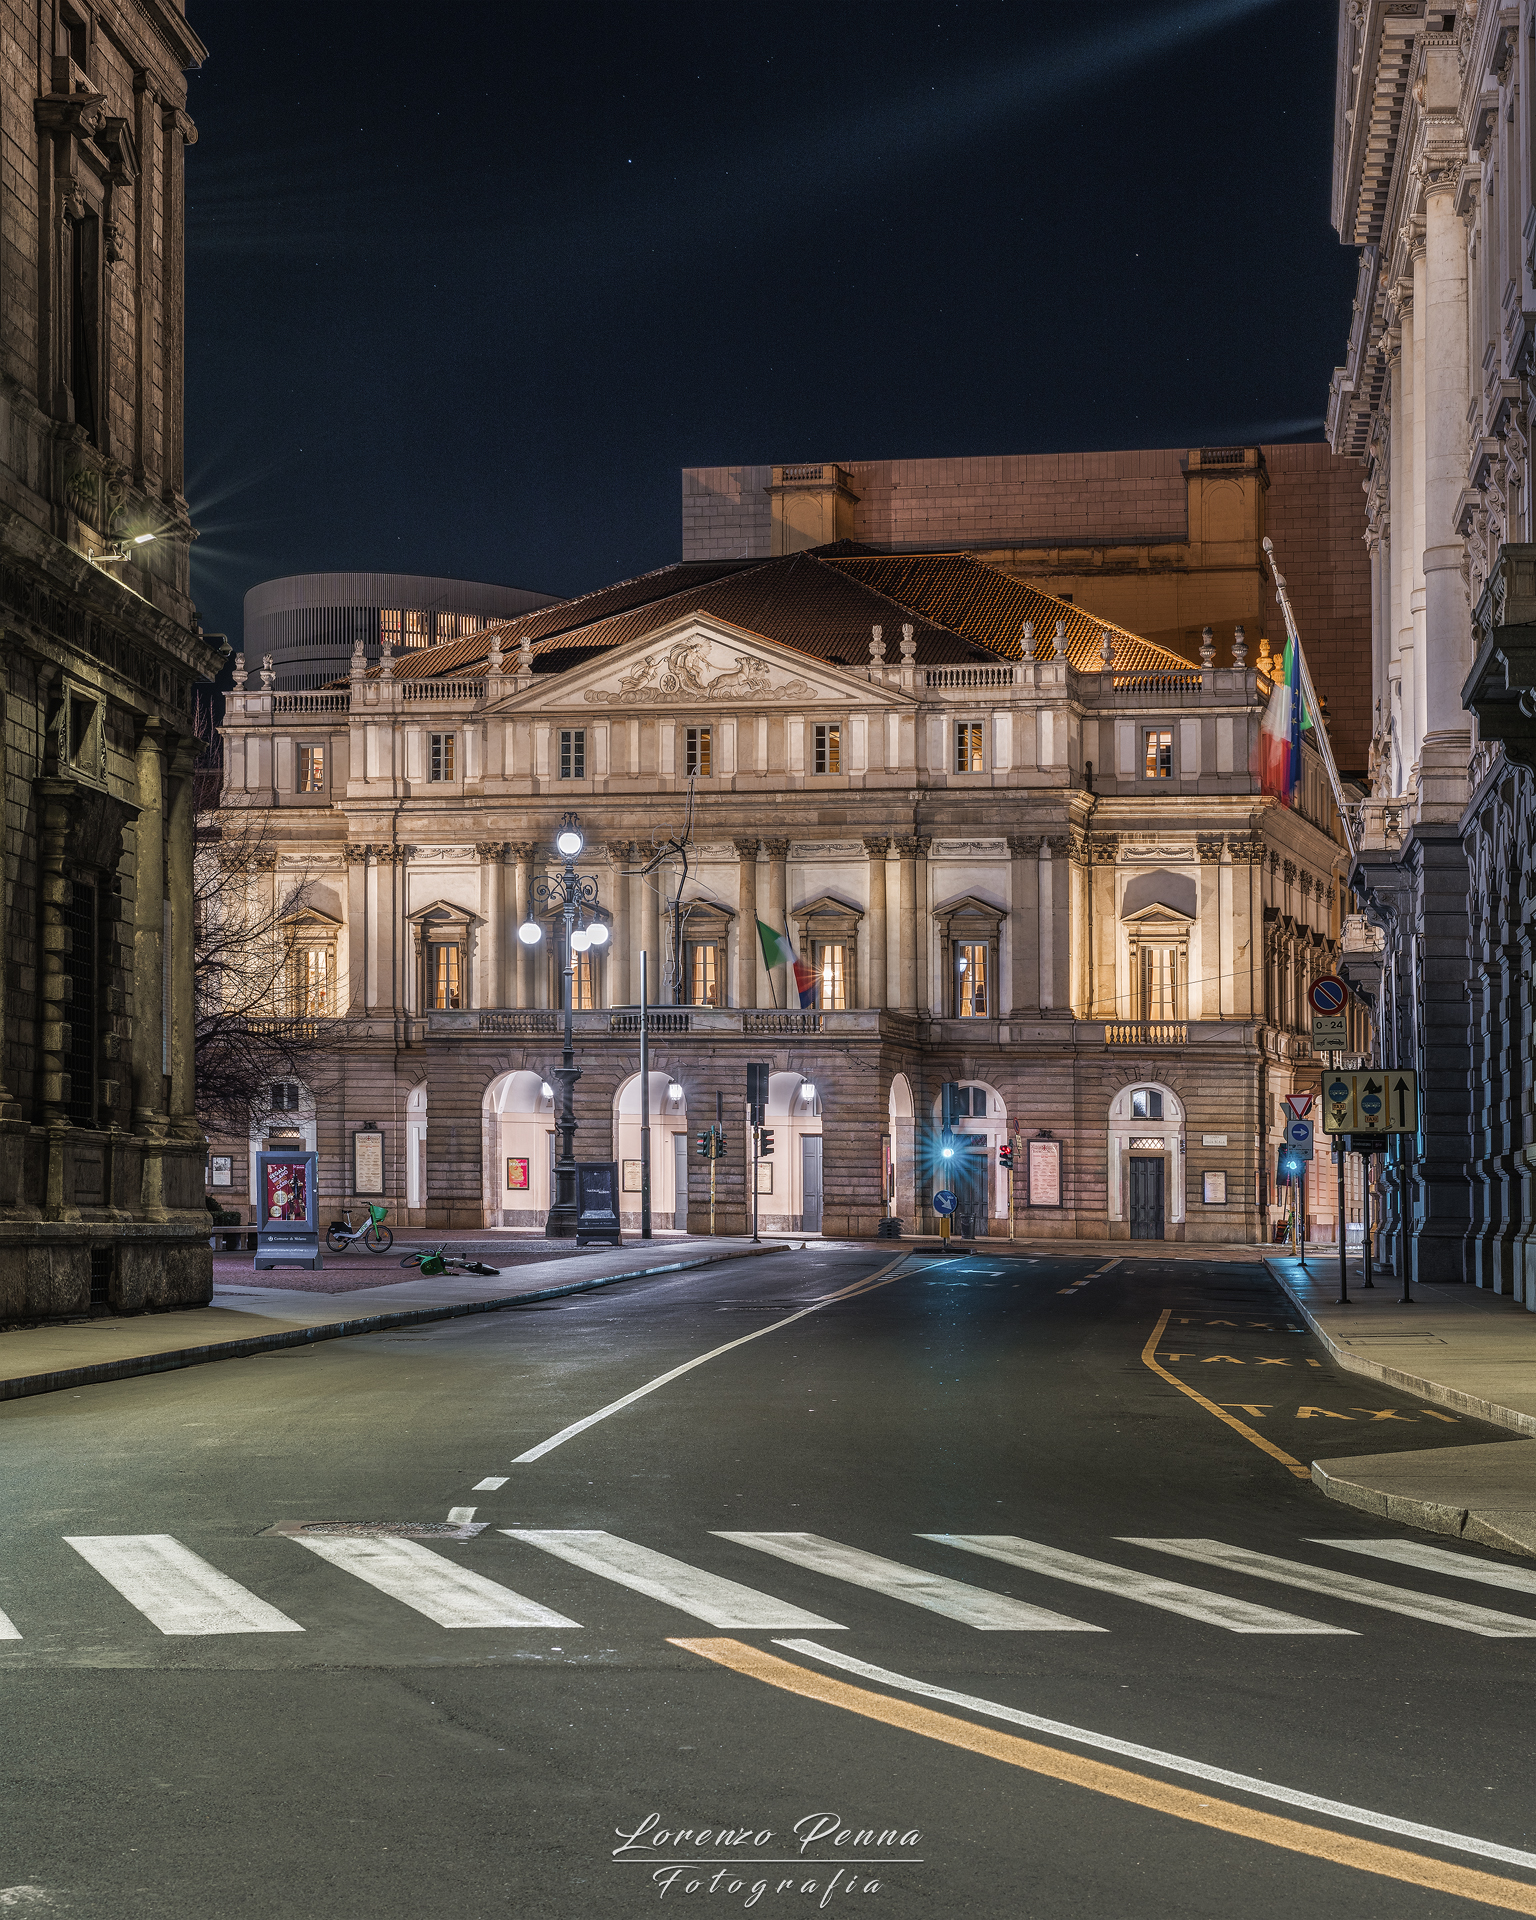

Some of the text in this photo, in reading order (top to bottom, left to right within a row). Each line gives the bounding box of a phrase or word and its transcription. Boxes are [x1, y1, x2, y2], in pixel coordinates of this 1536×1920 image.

[1316, 1021, 1323, 1029] 0
[1330, 1020, 1343, 1029] 24
[269, 1165, 288, 1179] REGALA
[1170, 1317, 1298, 1330] TAXI
[1155, 1352, 1322, 1367] TAXI
[1219, 1403, 1461, 1423] TAXI
